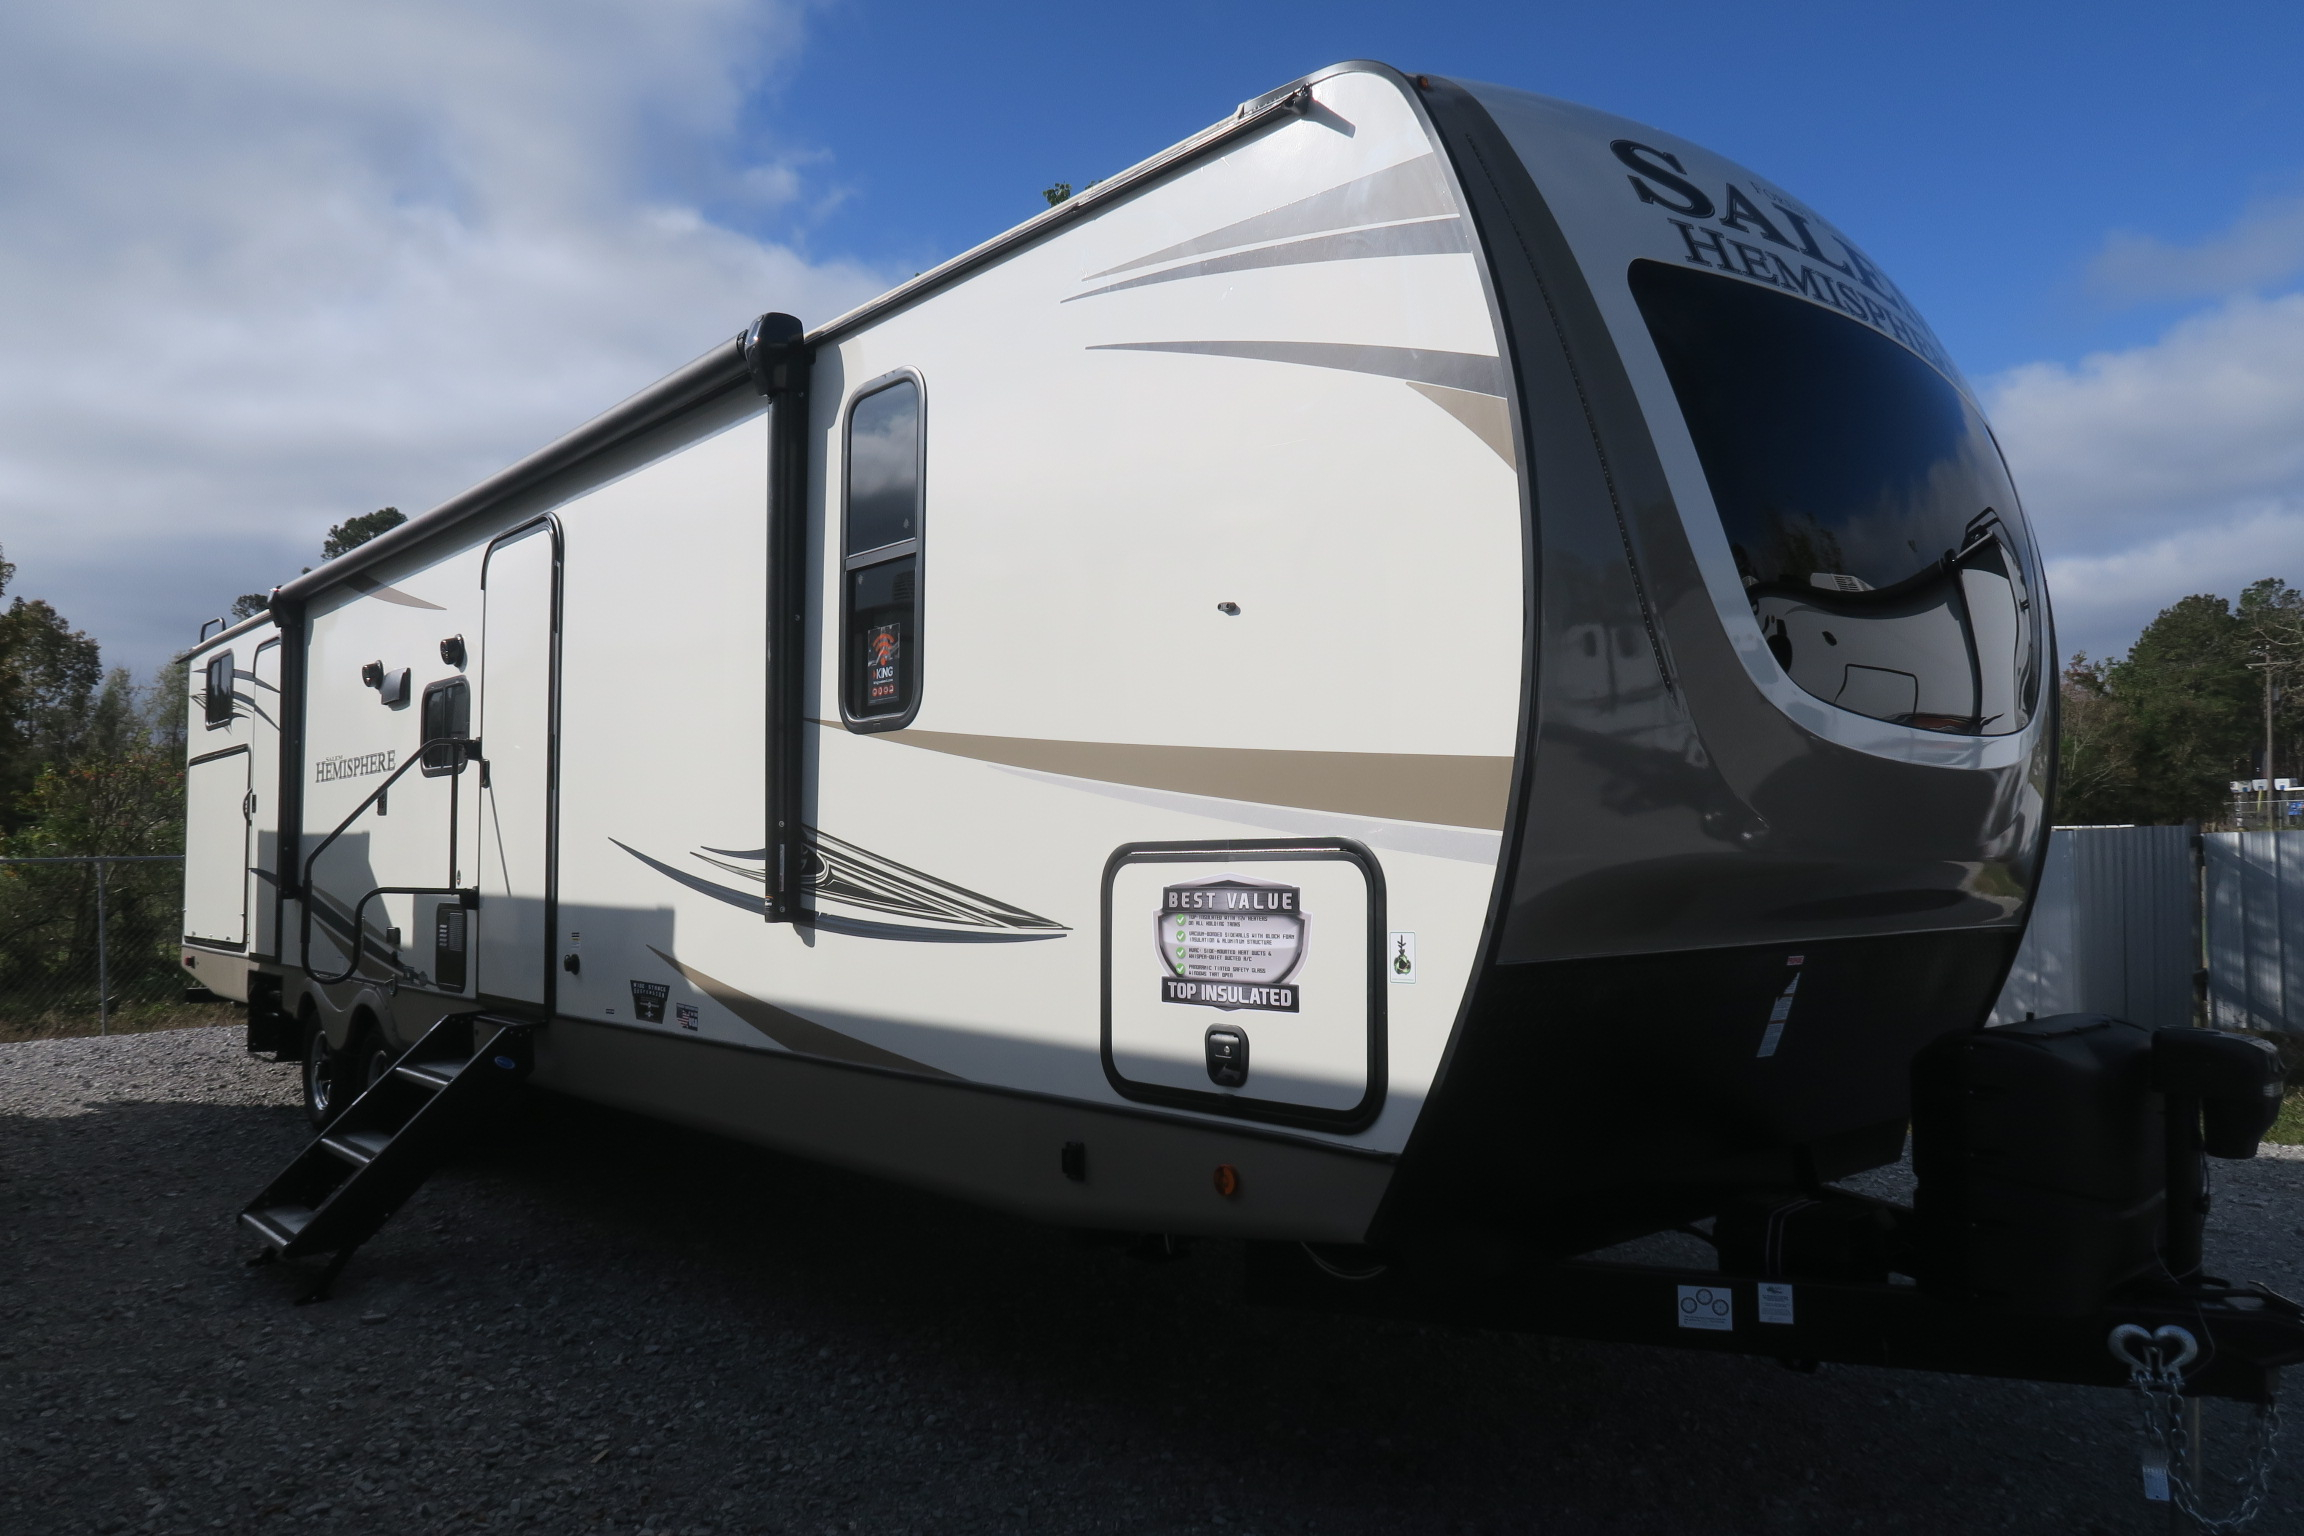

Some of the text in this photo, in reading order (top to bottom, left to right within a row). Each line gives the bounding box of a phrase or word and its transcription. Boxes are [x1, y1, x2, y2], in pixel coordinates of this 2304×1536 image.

[876, 666, 894, 679] KING
[315, 750, 396, 783] HEMISPHERE
[1168, 891, 1293, 910] BEST VALUE
[1168, 981, 1292, 1007] TOP INSULATED
